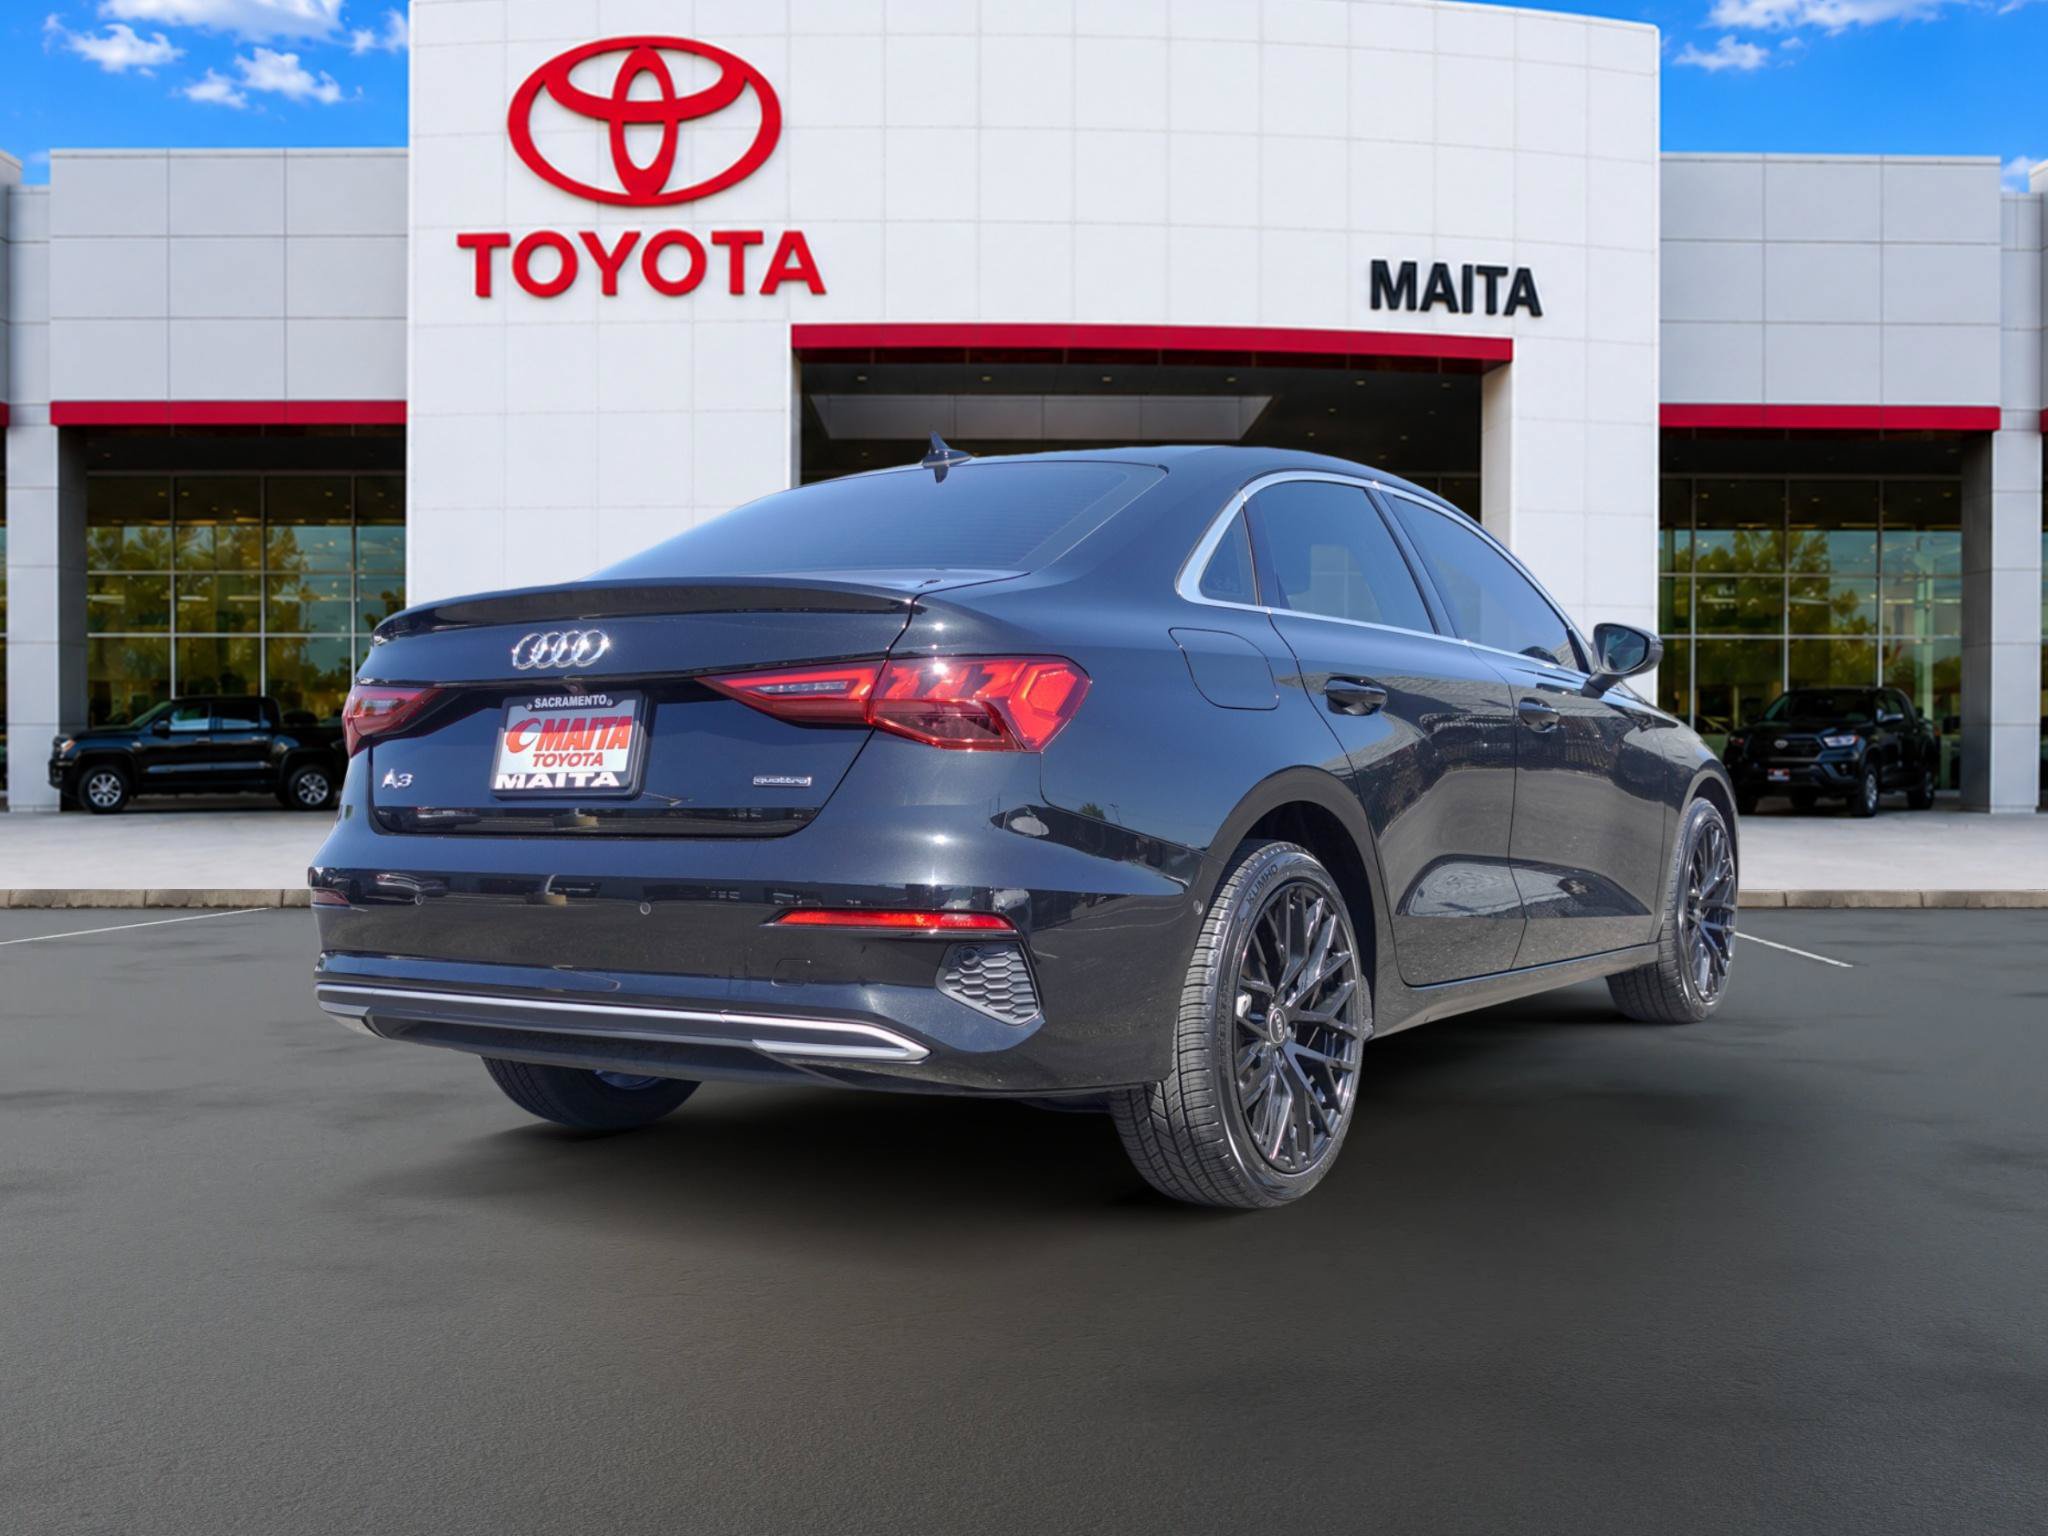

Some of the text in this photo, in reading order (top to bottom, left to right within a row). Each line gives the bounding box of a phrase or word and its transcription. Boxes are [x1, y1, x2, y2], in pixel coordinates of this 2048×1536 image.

[457, 230, 826, 298] TOYOTA
[1370, 259, 1543, 317] MAITA
[534, 694, 607, 709] SACRAMENTO
[533, 752, 604, 768] TOYOTA
[382, 768, 413, 788] A3
[494, 771, 620, 790] MAITA
